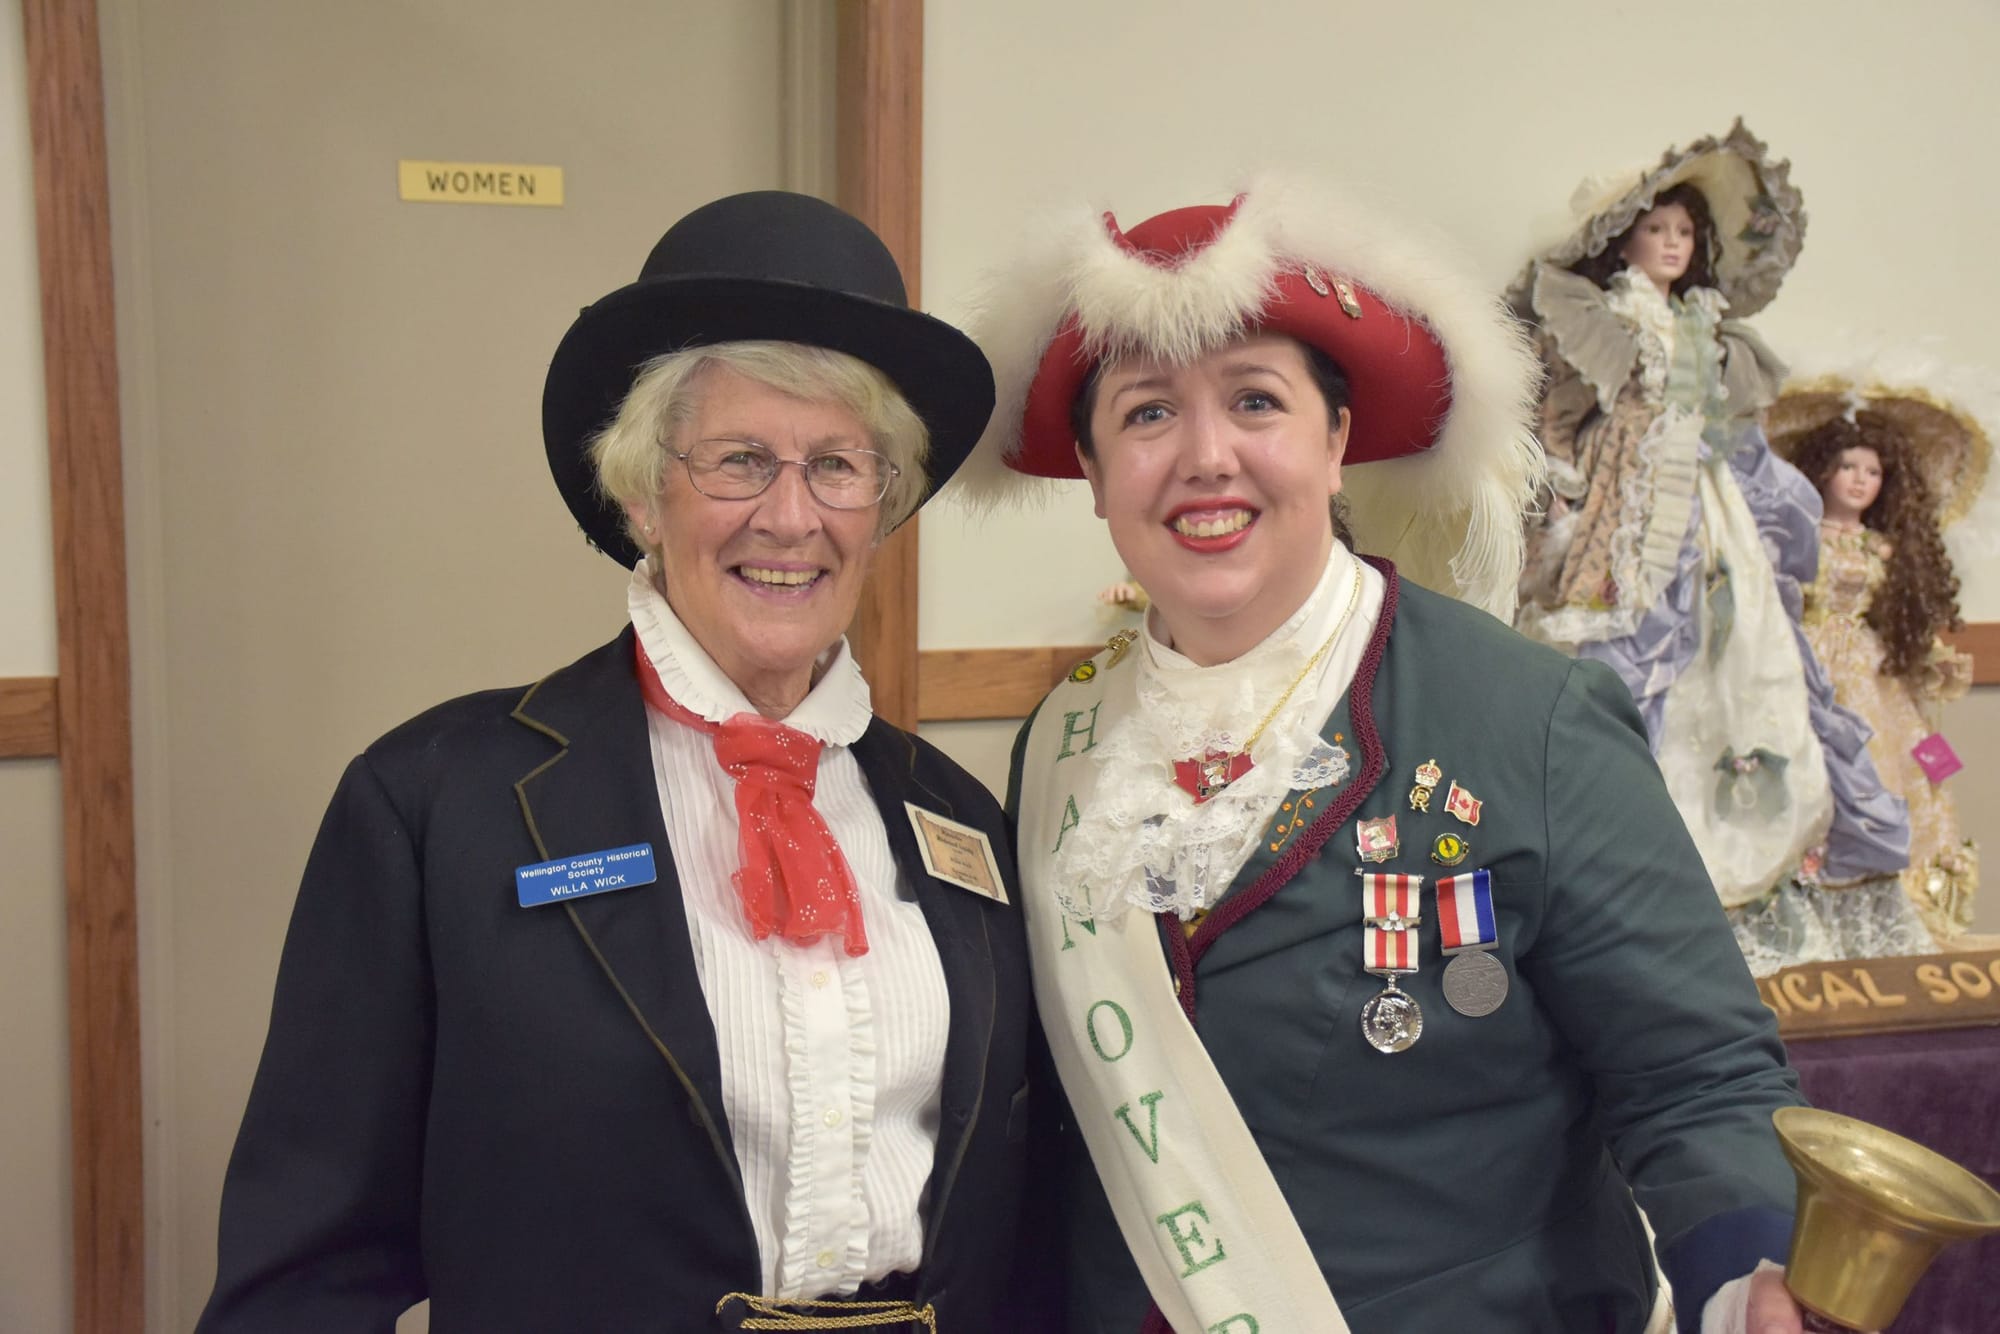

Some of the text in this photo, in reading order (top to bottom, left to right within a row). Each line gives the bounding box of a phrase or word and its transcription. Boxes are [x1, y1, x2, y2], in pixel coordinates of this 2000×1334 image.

[426, 170, 536, 196] WOMEN
[520, 848, 649, 879] Wellington County Historical
[567, 867, 605, 879] Society
[550, 874, 626, 896] WILLA WICK
[1915, 959, 2000, 1004] SO
